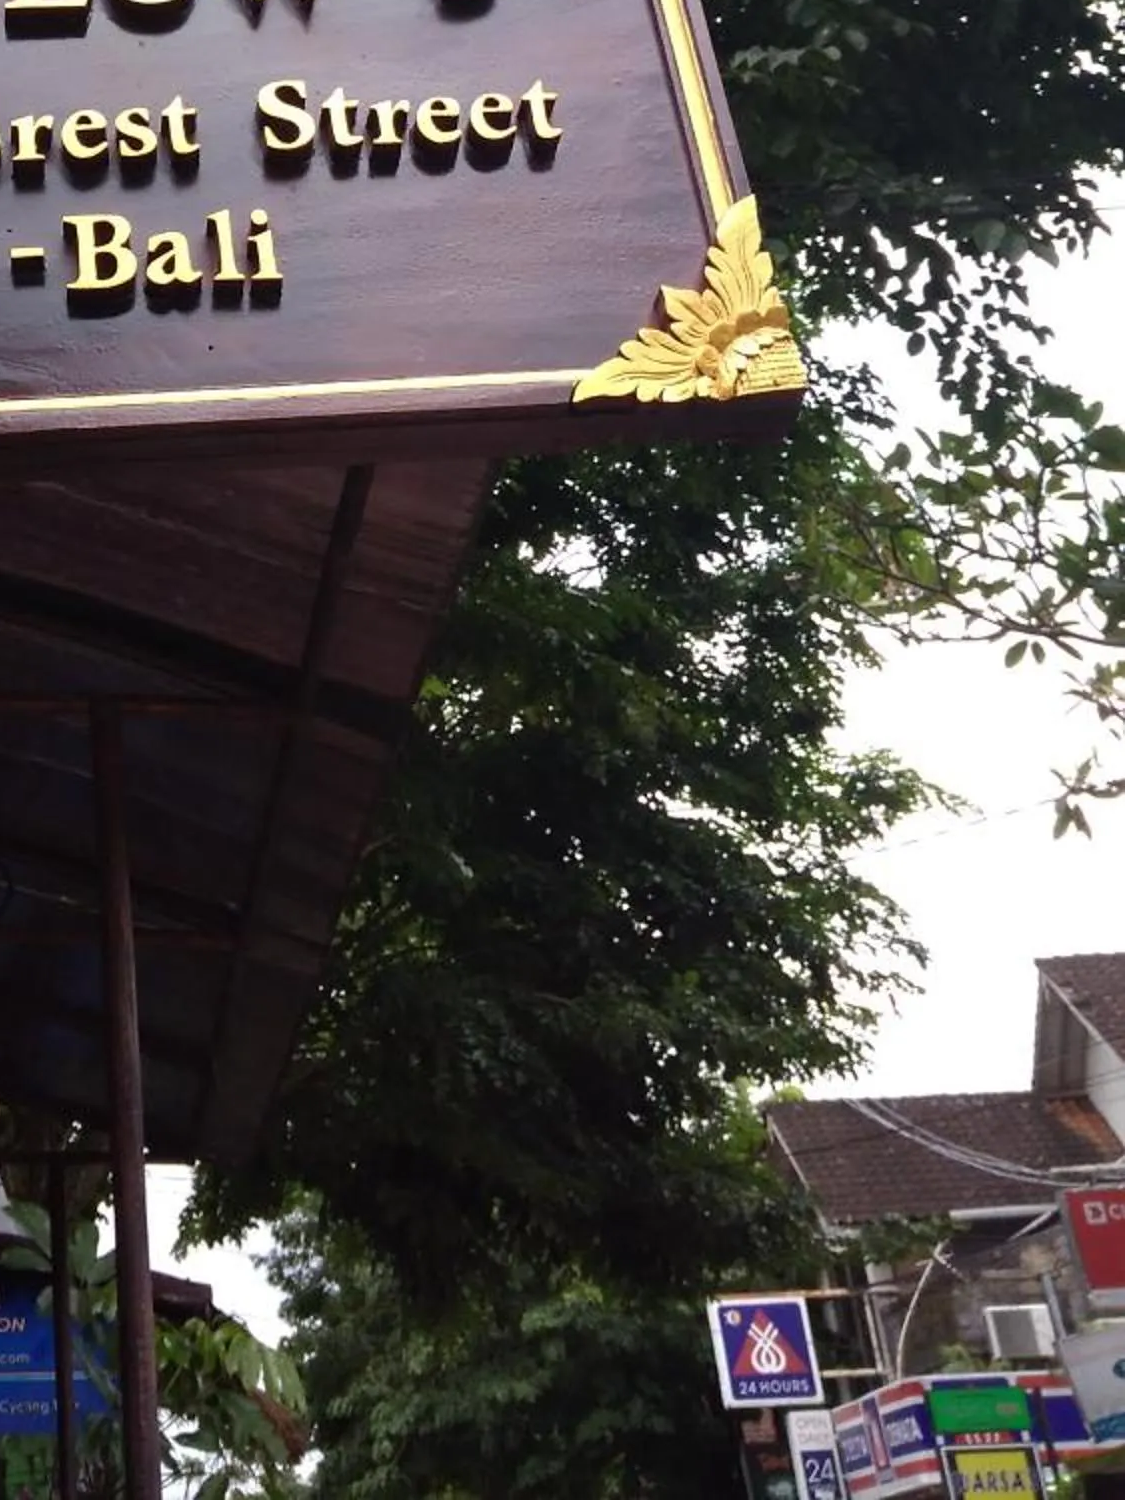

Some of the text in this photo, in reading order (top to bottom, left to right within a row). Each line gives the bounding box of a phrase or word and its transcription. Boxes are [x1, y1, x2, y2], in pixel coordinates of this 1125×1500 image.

[255, 77, 565, 151] Street
[738, 1378, 809, 1395] 24 HOURS
[805, 1457, 835, 1484] 24
